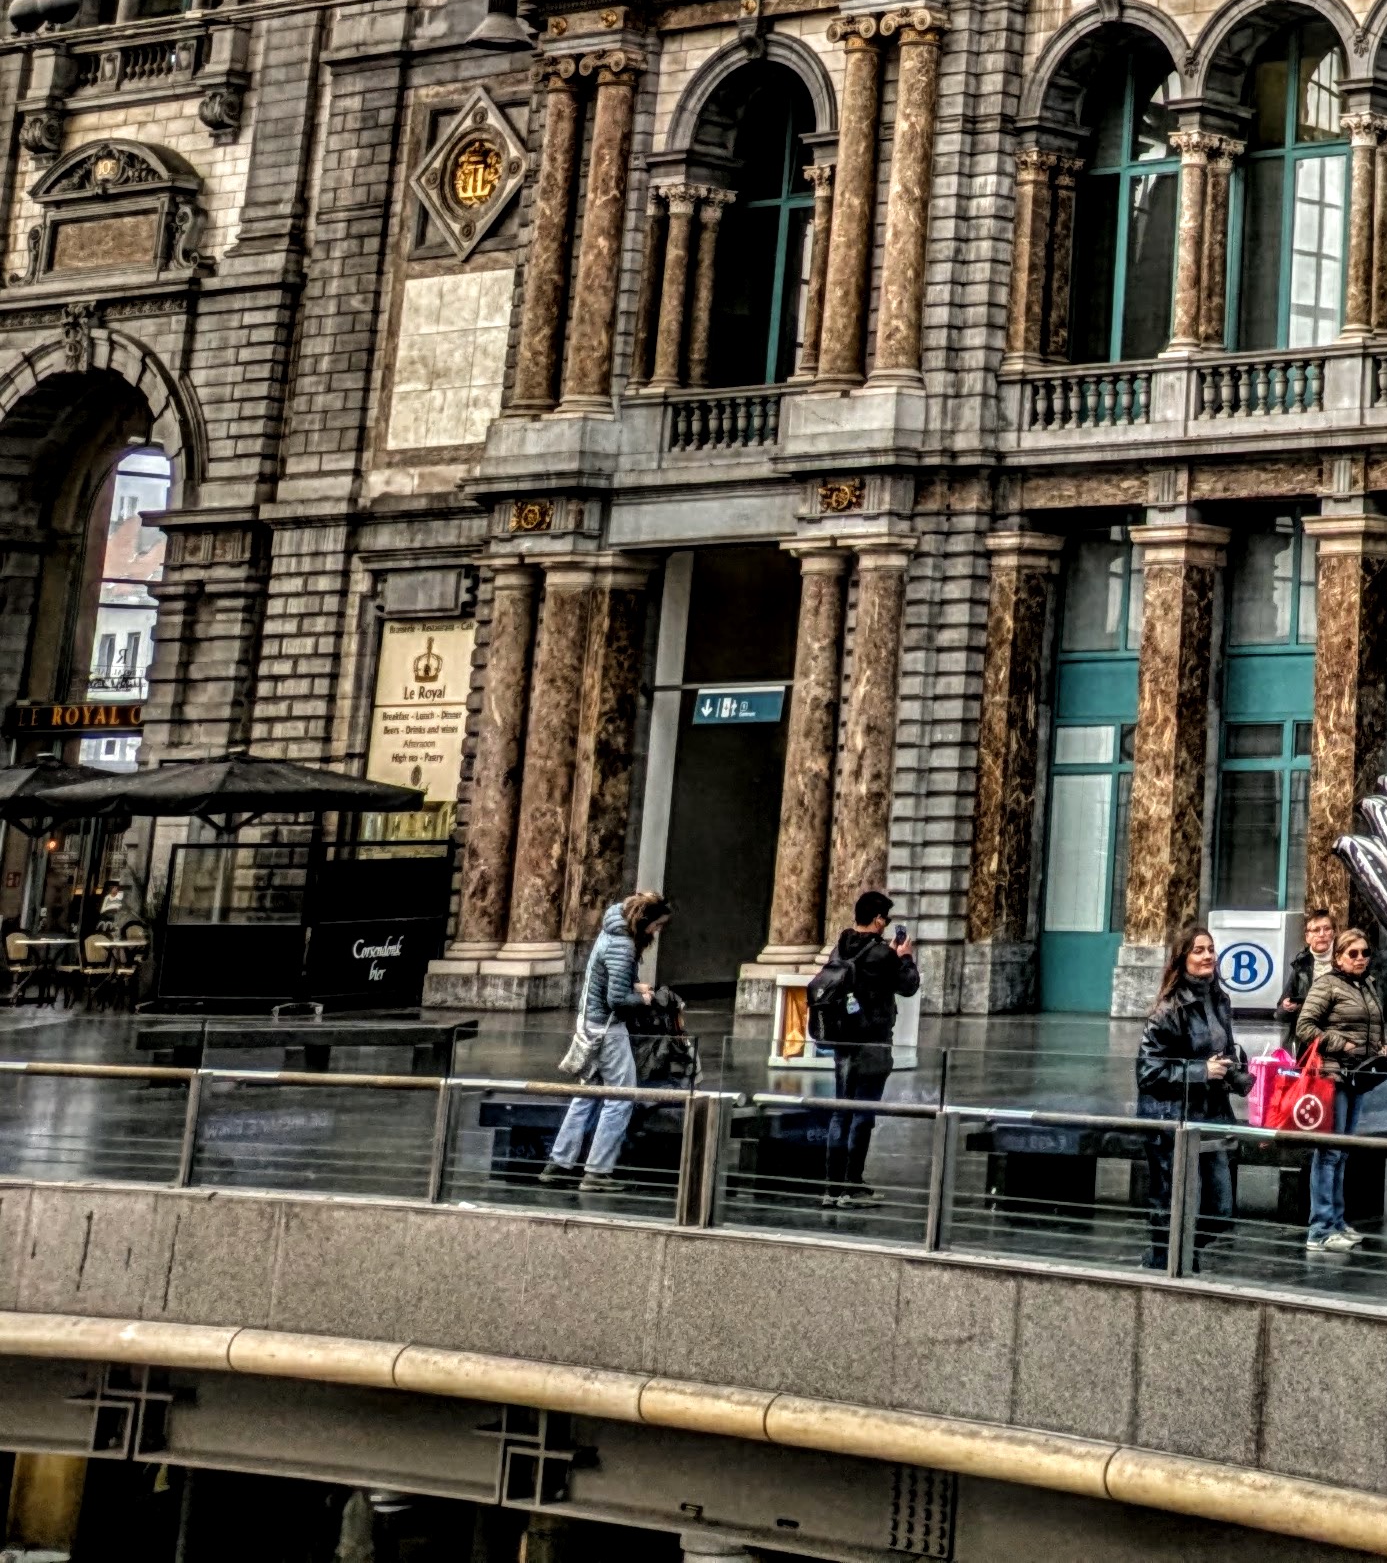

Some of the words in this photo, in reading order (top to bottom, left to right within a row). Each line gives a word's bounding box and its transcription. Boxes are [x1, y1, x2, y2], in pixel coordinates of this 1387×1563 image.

[404, 686, 415, 700] Le
[418, 684, 446, 702] Royal
[18, 708, 40, 726] LE
[51, 706, 120, 726] ROYAL
[383, 726, 399, 734] Beers
[427, 725, 439, 733] and
[1232, 950, 1258, 985] B
